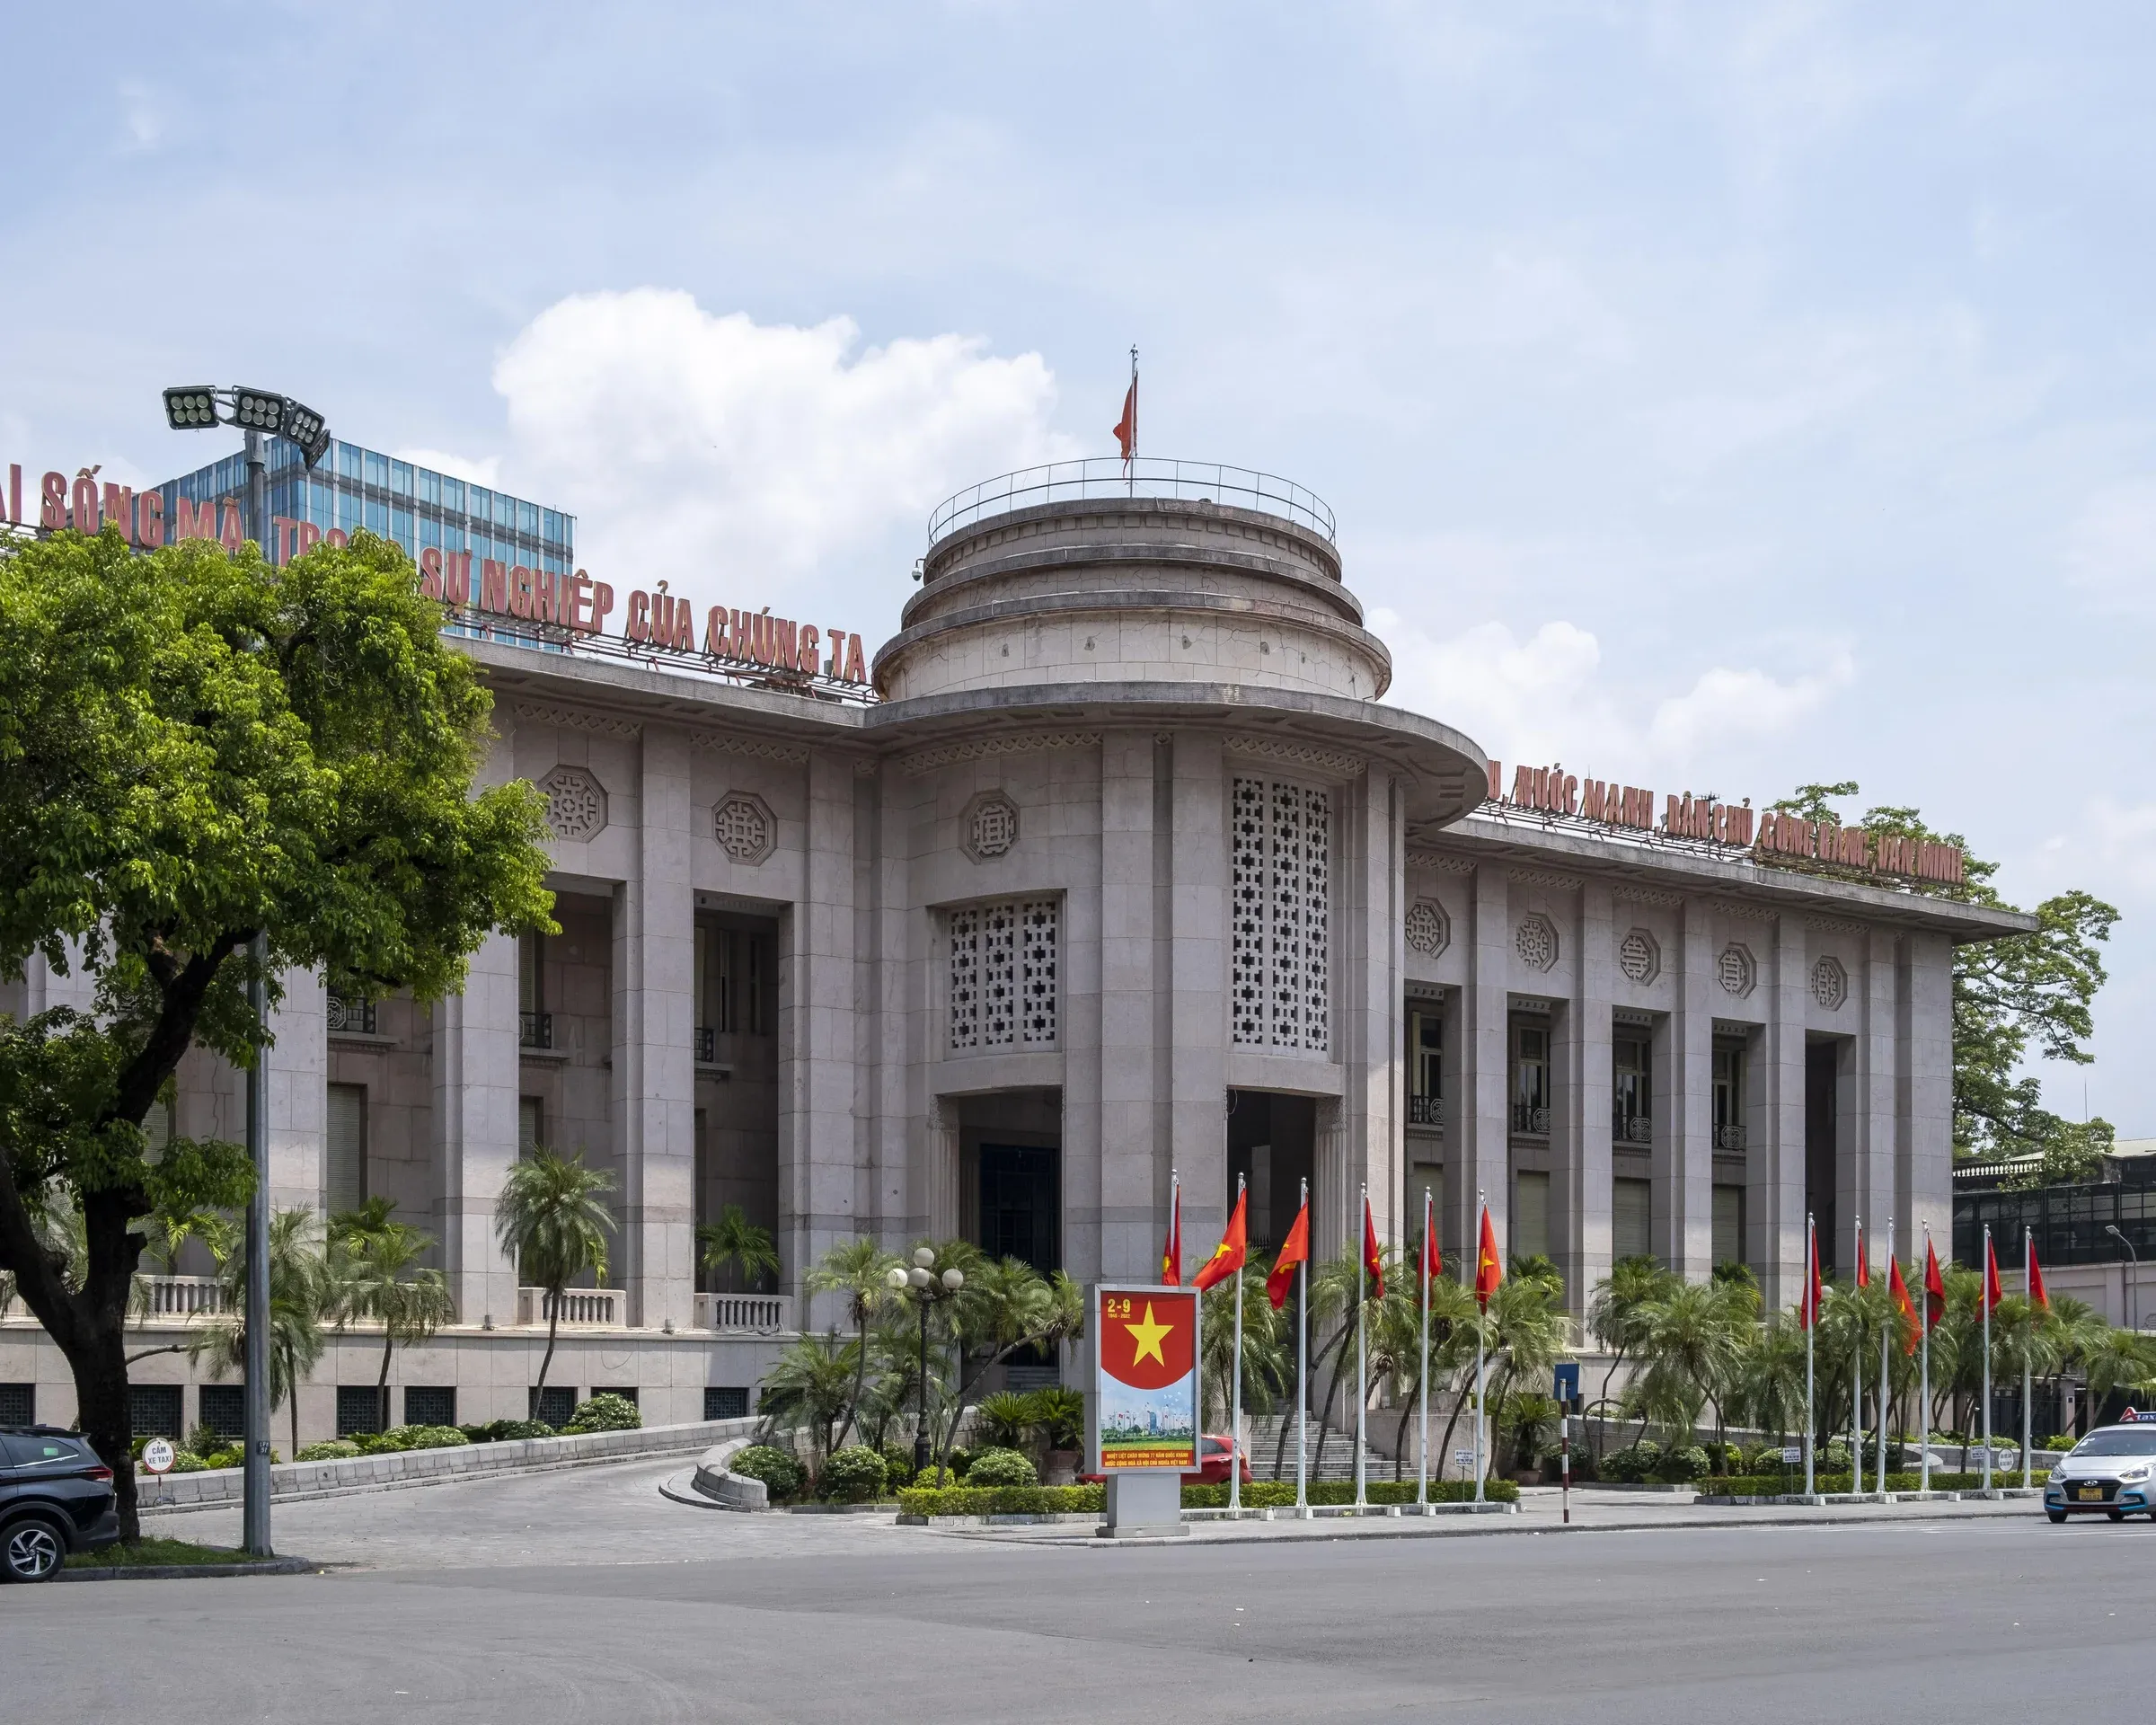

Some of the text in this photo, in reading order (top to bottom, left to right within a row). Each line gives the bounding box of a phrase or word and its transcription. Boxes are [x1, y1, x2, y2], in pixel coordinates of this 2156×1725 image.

[0, 464, 22, 524] I
[40, 464, 164, 546] SỐNG
[420, 547, 473, 615] SỰ
[481, 559, 614, 640] NGHIỆP
[628, 579, 695, 651] CỦA
[708, 606, 819, 674] CHÚNG
[827, 628, 867, 683] TA
[1515, 762, 1578, 815] NƯỚC
[1667, 791, 1709, 839] DÂN
[1762, 809, 1815, 857] CÔNG
[1917, 840, 1963, 884] MINH
[157, 1455, 172, 1464] TAXI
